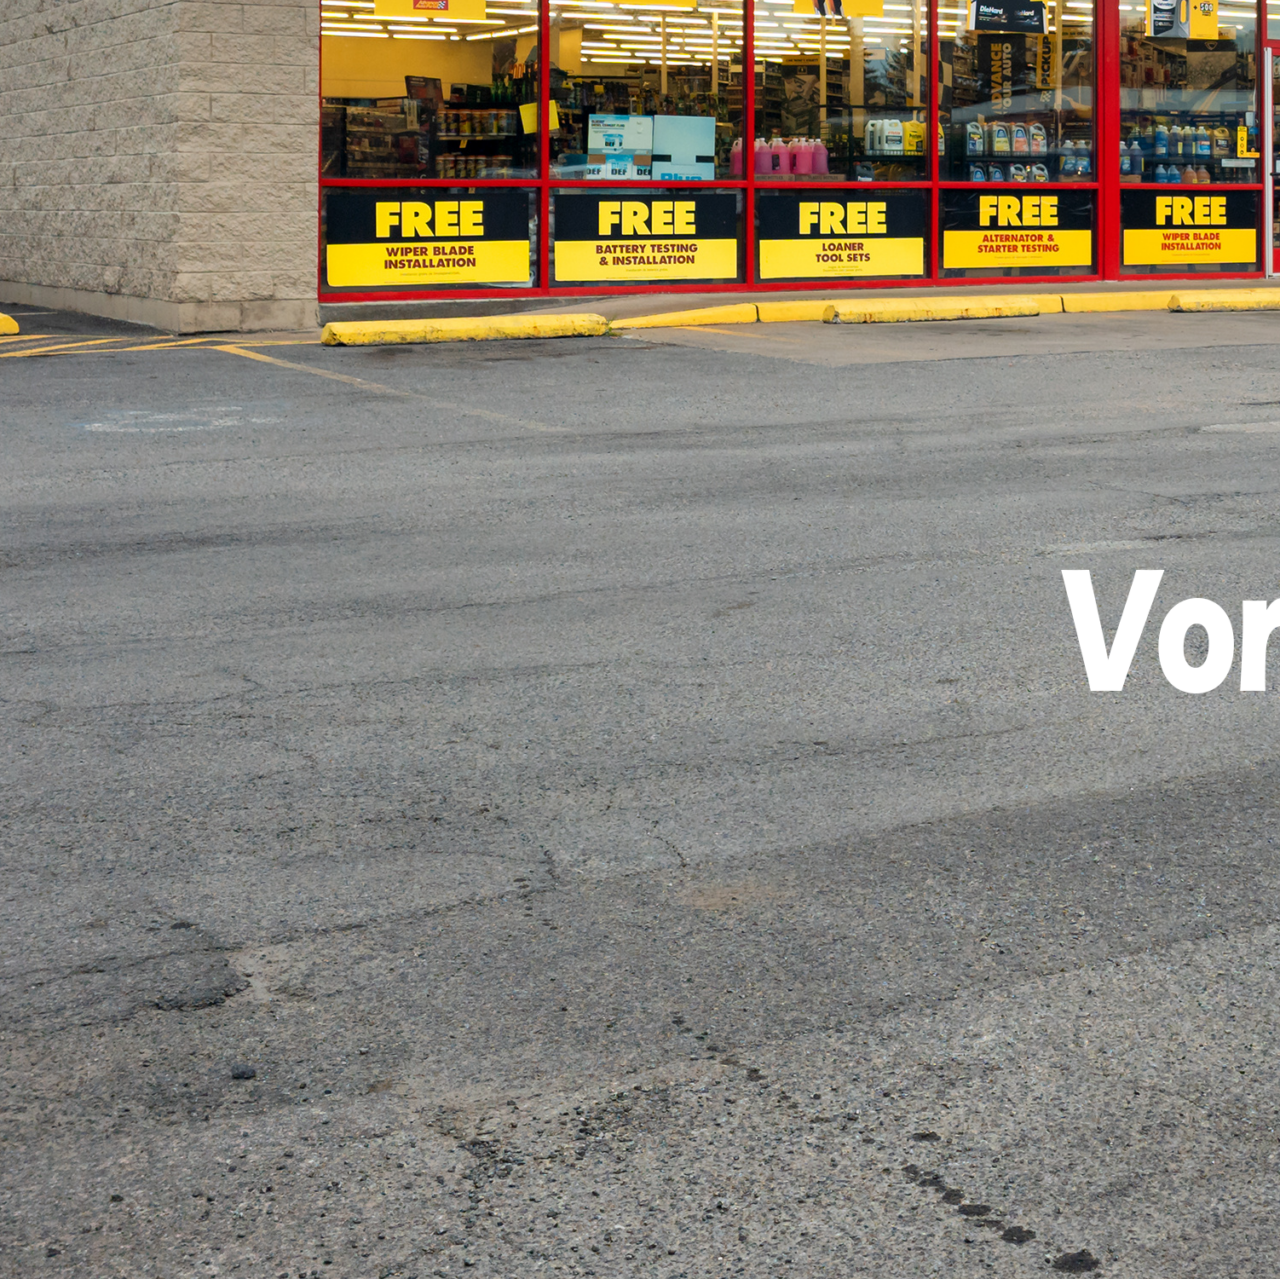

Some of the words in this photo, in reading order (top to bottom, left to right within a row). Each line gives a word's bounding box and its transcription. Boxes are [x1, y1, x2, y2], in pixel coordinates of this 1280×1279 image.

[979, 5, 1003, 14] DieHard
[1002, 43, 1012, 77] AUTO
[1041, 36, 1051, 87] PICKUP
[990, 43, 1003, 115] ADVANCE
[979, 196, 1058, 226] FREE
[1156, 197, 1227, 225] FREE
[376, 201, 484, 238] FREE
[599, 201, 696, 235] FREE
[799, 202, 887, 234] FREE
[982, 234, 1043, 242] ALTERNATOR
[1047, 234, 1054, 242] &
[386, 247, 428, 256] WIPER
[433, 246, 474, 255] BLADE
[596, 244, 646, 254] BATTERY
[650, 243, 698, 253] TESTING
[822, 243, 864, 251] LOANER
[978, 244, 1018, 253] STARTER
[1021, 243, 1059, 252] TESTING
[1161, 242, 1221, 251] INSTALLATION
[599, 257, 608, 266] &
[612, 255, 695, 265] INSTALLATION
[816, 253, 844, 262] TOOL
[847, 253, 870, 262] SETS
[384, 258, 476, 269] INSTALLATION
